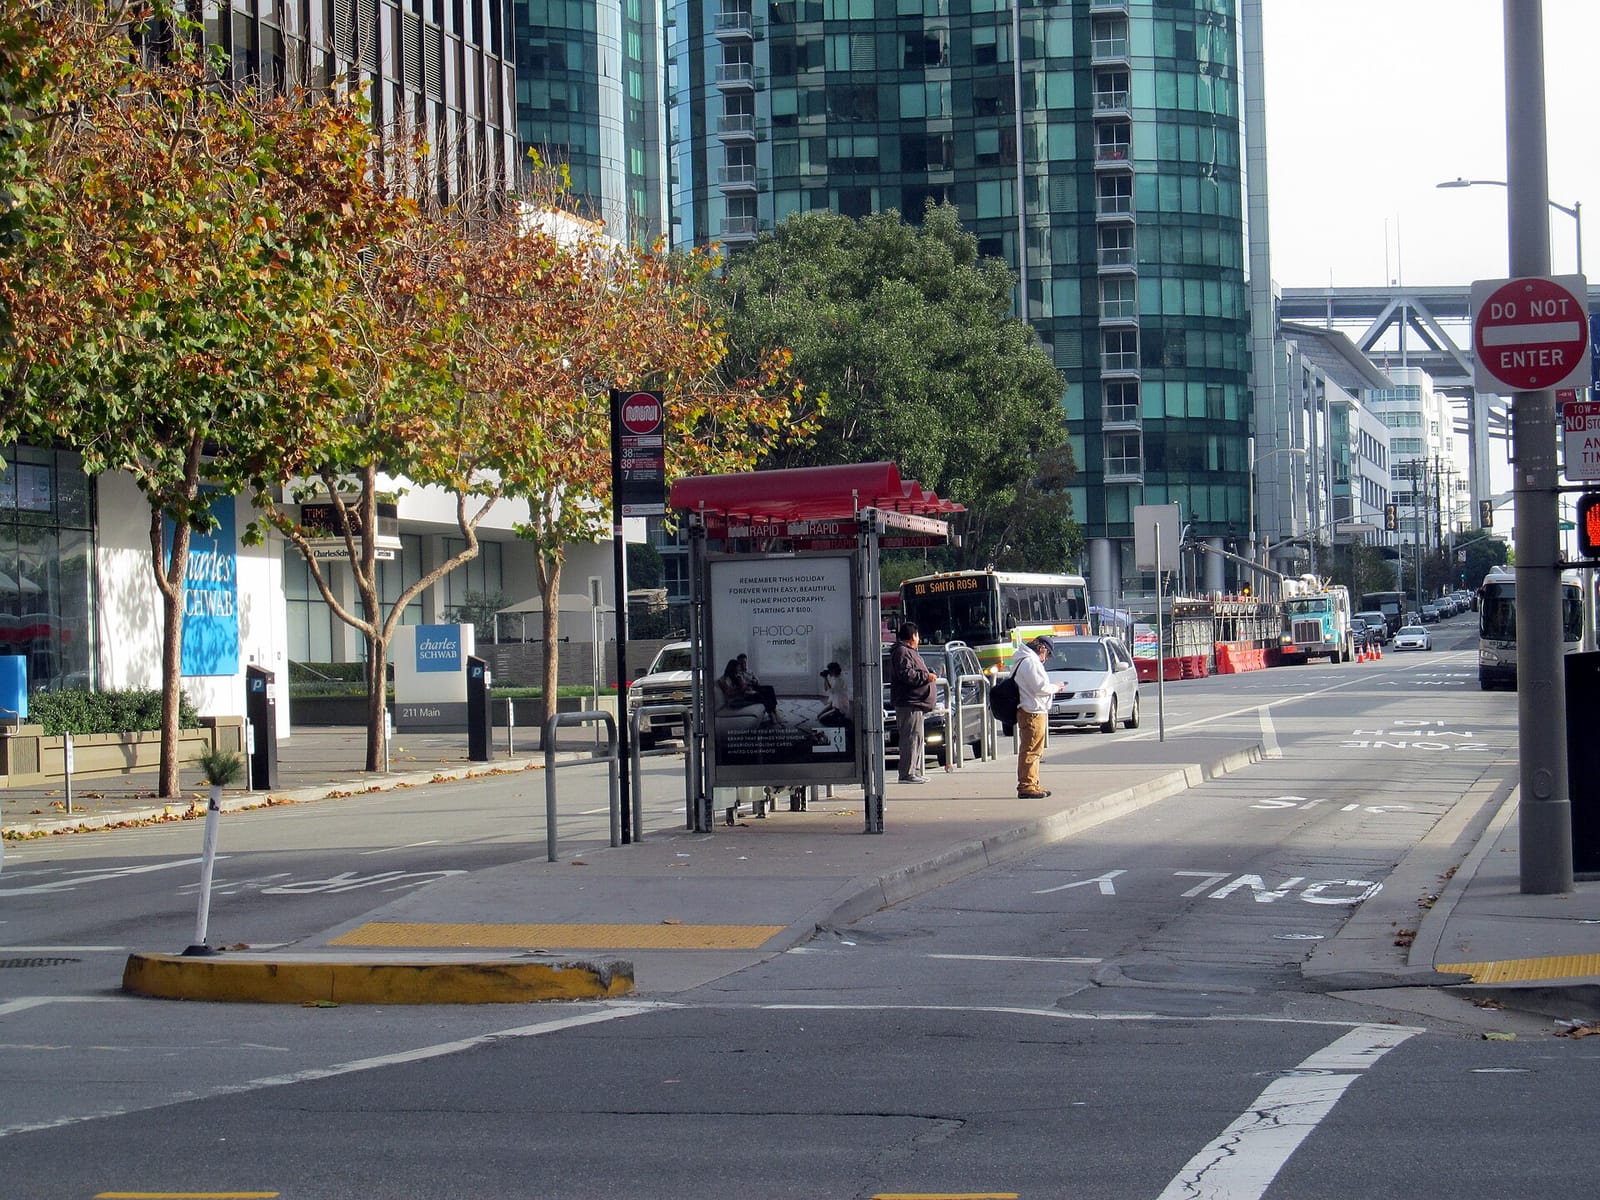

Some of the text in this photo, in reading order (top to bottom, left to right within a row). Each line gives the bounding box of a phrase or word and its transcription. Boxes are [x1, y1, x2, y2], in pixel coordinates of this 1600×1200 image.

[1491, 299, 1569, 320] DO NOT
[1500, 349, 1564, 369] ENTER
[1565, 415, 1584, 431] NO
[622, 448, 633, 458] 38
[624, 470, 630, 480] 7
[305, 508, 328, 519] TIME
[749, 525, 779, 537] RAPID
[809, 522, 839, 535] RAPID
[914, 578, 978, 595] 101 SANTA ROSA
[181, 588, 233, 617] CHWAB
[420, 637, 456, 650] charles
[419, 651, 457, 659] SCHWAB
[403, 708, 441, 718] 211 Main
[1352, 729, 1473, 738] MPH
[1339, 740, 1489, 751] ZONE
